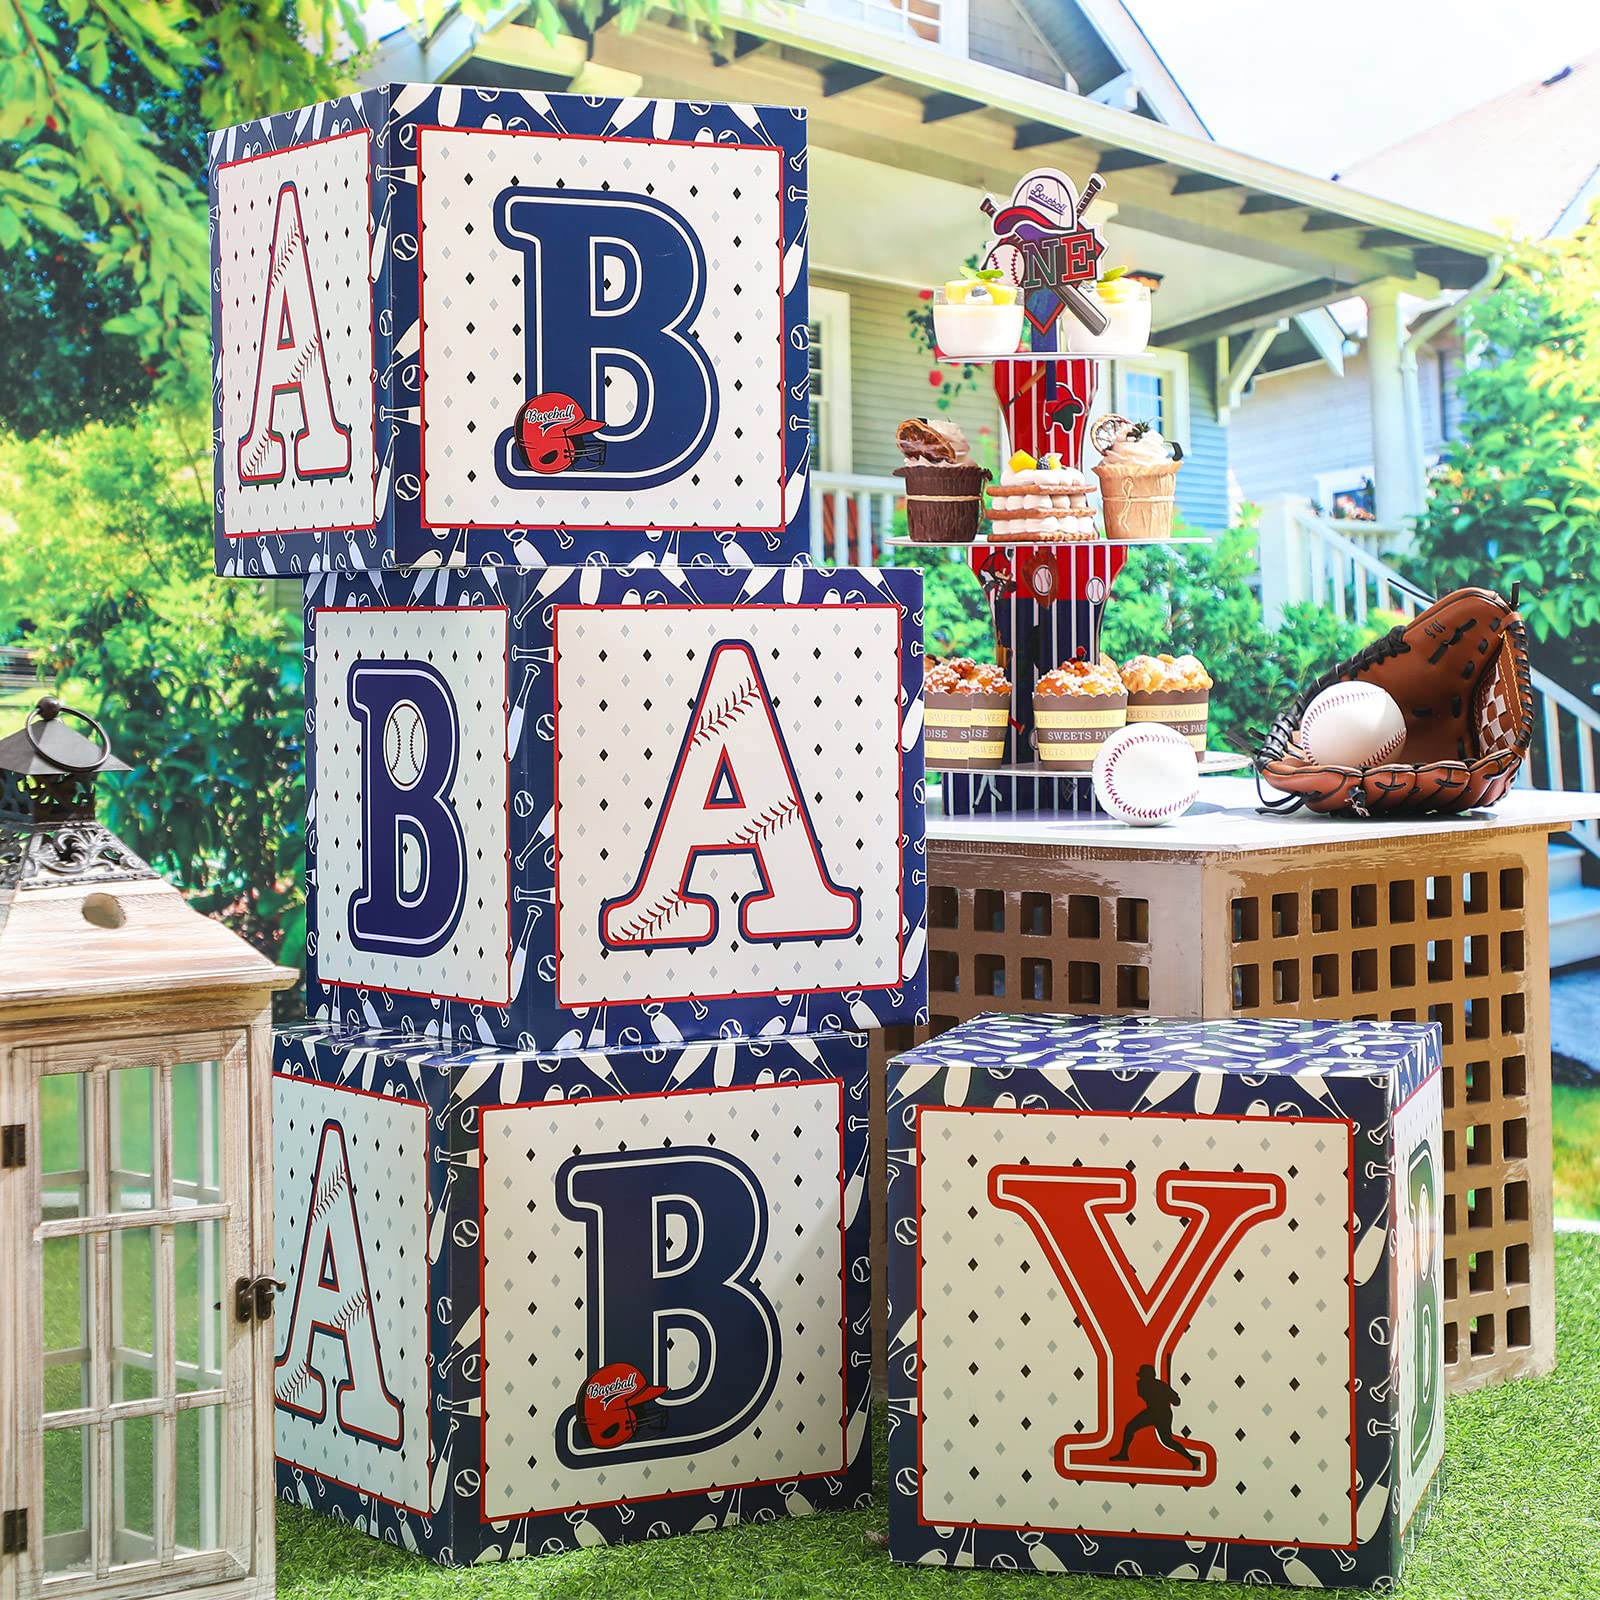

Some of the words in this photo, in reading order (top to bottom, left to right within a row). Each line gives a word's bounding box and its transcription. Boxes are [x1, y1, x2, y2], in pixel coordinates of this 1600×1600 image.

[238, 181, 351, 486] A
[493, 185, 720, 490] B
[1030, 184, 1067, 212] Baseball
[525, 404, 574, 423] Baseball
[347, 659, 467, 957] B
[600, 639, 861, 951] A
[1048, 731, 1091, 740] SWEETS
[275, 1119, 404, 1451] A
[555, 1145, 781, 1470] B
[587, 1373, 636, 1399] Baseball
[987, 1164, 1286, 1487] Y
[1408, 1139, 1438, 1477] B
